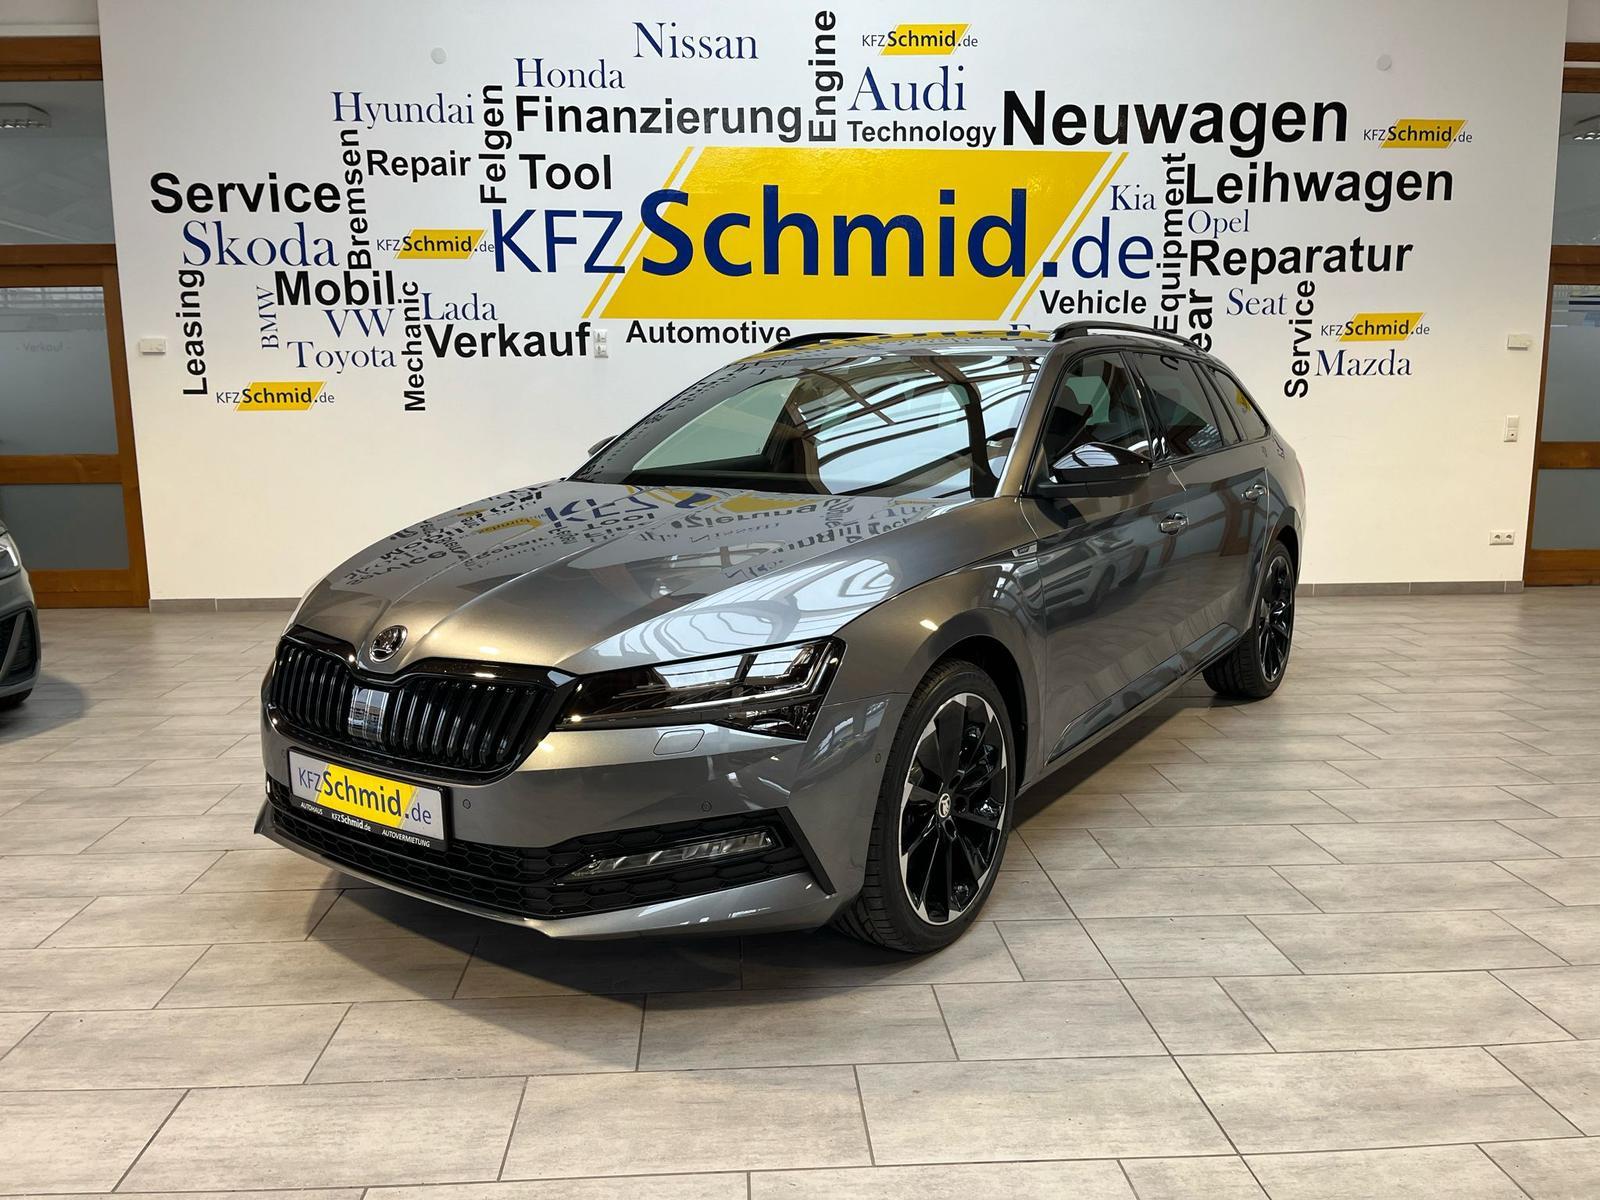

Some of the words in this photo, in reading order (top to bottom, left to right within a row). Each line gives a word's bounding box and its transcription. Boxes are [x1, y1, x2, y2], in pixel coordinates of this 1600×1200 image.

[632, 22, 759, 60] Nissan
[861, 28, 978, 49] KFZSchmid.de
[514, 58, 625, 90] Honda
[808, 10, 843, 142] Engine
[848, 65, 967, 112] Audi
[331, 91, 475, 129] Hyundai
[515, 94, 801, 143] Finanzierung
[1003, 90, 1348, 159] Neuwagen
[478, 84, 512, 204] Felgen
[847, 119, 997, 148] Technology
[1363, 125, 1473, 145] KFZSchmid.de
[366, 149, 472, 184] Repair
[518, 153, 612, 191] Tool
[149, 171, 341, 214] Service
[339, 129, 371, 270] Bremsen
[1110, 184, 1157, 211] Kia
[1186, 161, 1454, 213] Leihwagen
[492, 184, 1154, 279] KFZSchmid.de
[1187, 208, 1250, 239] Opel
[182, 219, 340, 267] Skoda
[376, 234, 495, 255] KFZSchmid.de
[1153, 152, 1188, 334] Equipment
[1189, 235, 1414, 285] Reparatur
[274, 269, 396, 307] Mobil
[420, 292, 499, 321] Lada
[1039, 289, 1147, 315] Vehicle
[1226, 287, 1288, 316] Seat
[175, 269, 208, 395] Leasing
[256, 286, 279, 350] BMW
[321, 308, 395, 339] VW
[625, 319, 792, 345] Automotive
[1188, 288, 1213, 353] ear
[1320, 319, 1430, 337] KFZSchmid.de
[287, 340, 397, 375] Toyota
[398, 281, 426, 411] Mechanic
[423, 321, 591, 359] Verkauf
[1283, 280, 1316, 398] Service
[1314, 348, 1413, 377] Mazda
[216, 387, 335, 406] KFZSchmid.de
[298, 766, 433, 825] KFZSchmid.de
[300, 801, 323, 816] AUTOHAUS
[331, 812, 371, 833] KFZSchmid.de
[381, 829, 431, 848] AUTOVERMIETUNG
